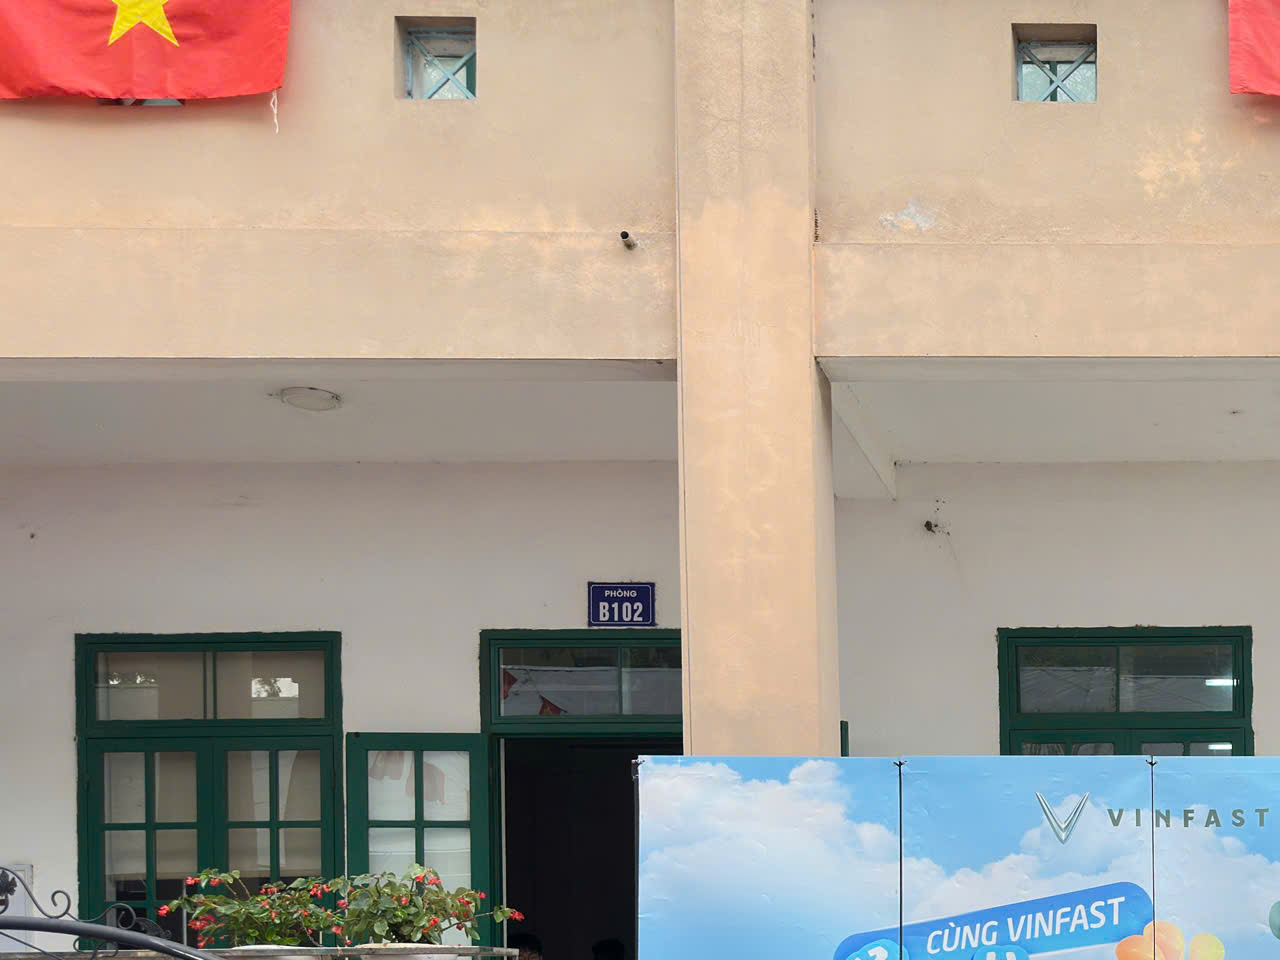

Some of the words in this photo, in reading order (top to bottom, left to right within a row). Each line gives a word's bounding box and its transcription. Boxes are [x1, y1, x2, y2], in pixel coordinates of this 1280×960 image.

[604, 588, 638, 598] PHÒNG
[599, 601, 643, 622] B102
[1107, 808, 1270, 828] VINFAST
[926, 920, 999, 955] CÙNG
[1007, 896, 1126, 942] VINFAST
